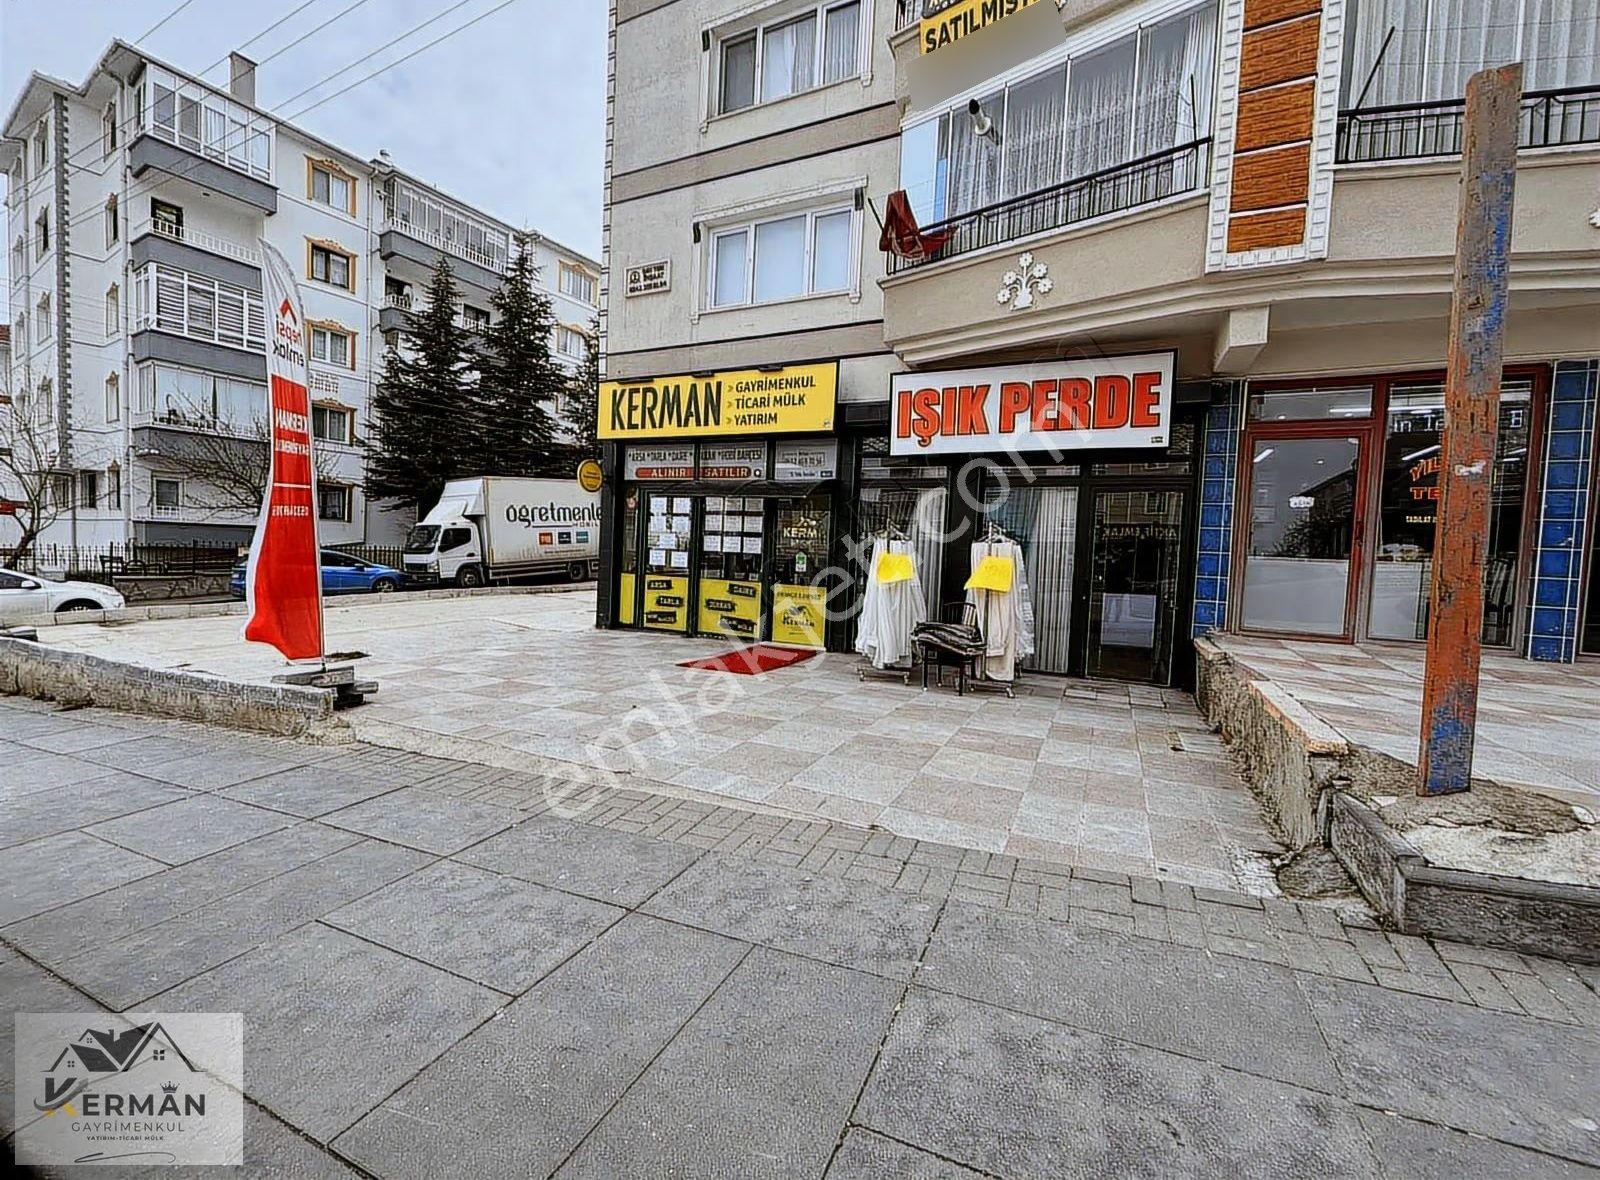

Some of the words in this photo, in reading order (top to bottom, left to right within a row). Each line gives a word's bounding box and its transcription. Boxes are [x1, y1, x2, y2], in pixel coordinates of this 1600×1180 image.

[735, 375, 817, 393] GAYRİMENKUL
[611, 381, 722, 431] KERMAN
[735, 393, 770, 410] TİCARİ
[773, 392, 806, 408] MÜLK
[897, 384, 992, 447] IŞIK
[999, 371, 1163, 433] PERDE
[734, 412, 778, 426] YATIRIM
[651, 468, 687, 478] ALINIR
[704, 467, 748, 477] SATILIR
